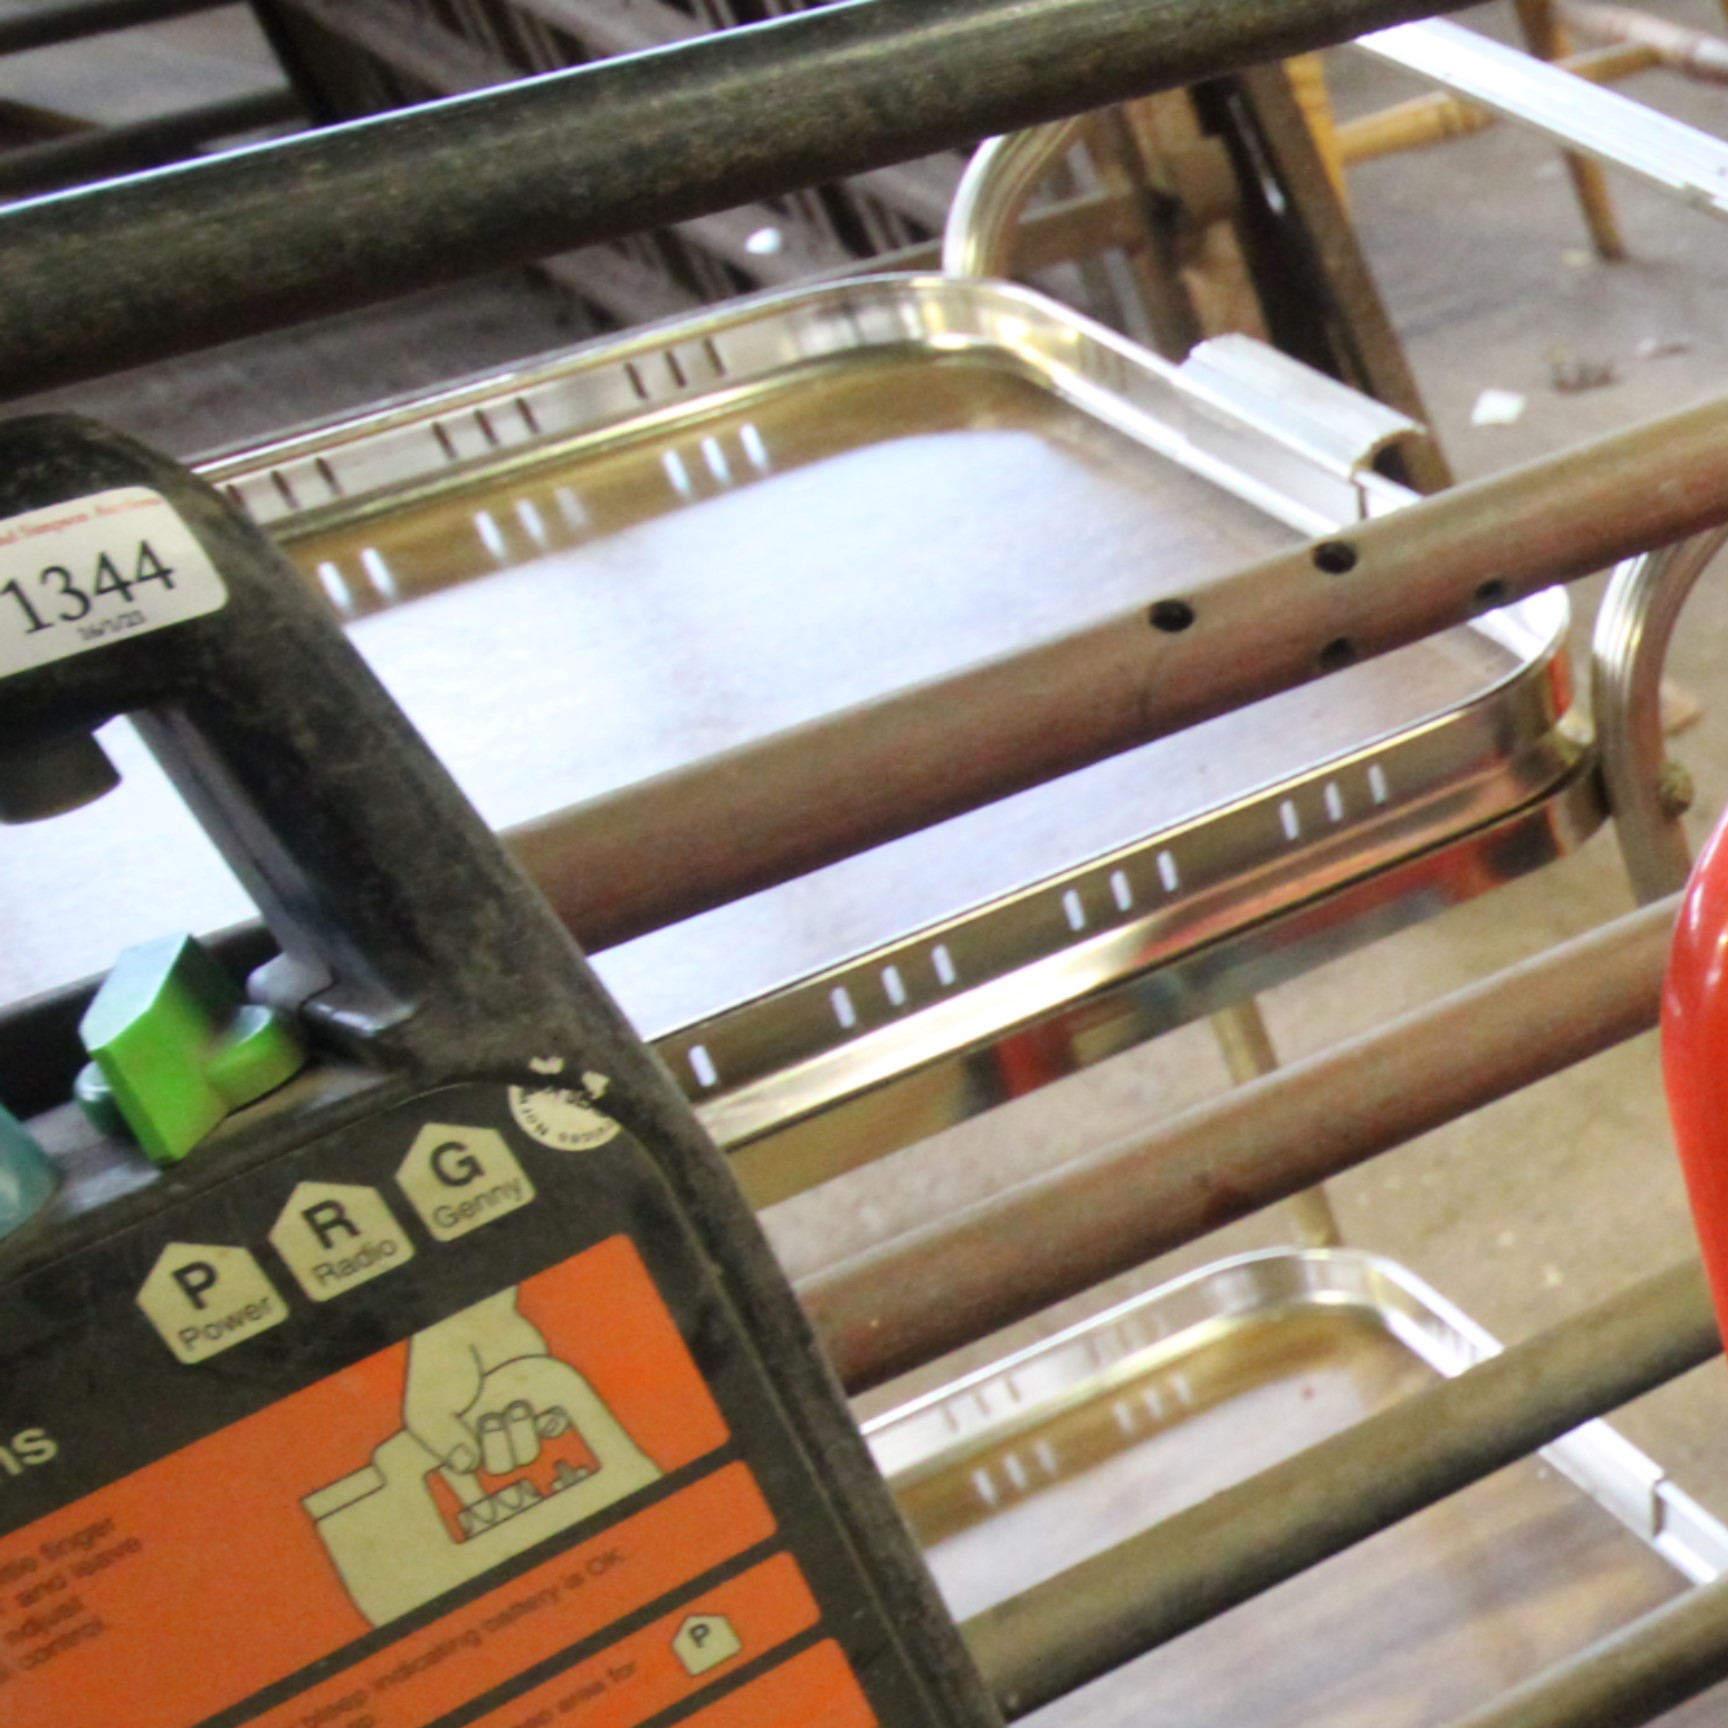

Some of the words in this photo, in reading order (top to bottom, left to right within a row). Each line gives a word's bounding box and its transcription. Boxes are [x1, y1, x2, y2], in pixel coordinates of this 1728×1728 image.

[0, 540, 176, 634] 1344
[429, 1140, 487, 1188] G
[300, 1199, 361, 1251] R
[432, 1178, 524, 1230] Genny
[172, 1260, 218, 1312] P
[311, 1236, 399, 1290] Radio
[178, 1293, 274, 1353] Power
[688, 1624, 712, 1651] P
